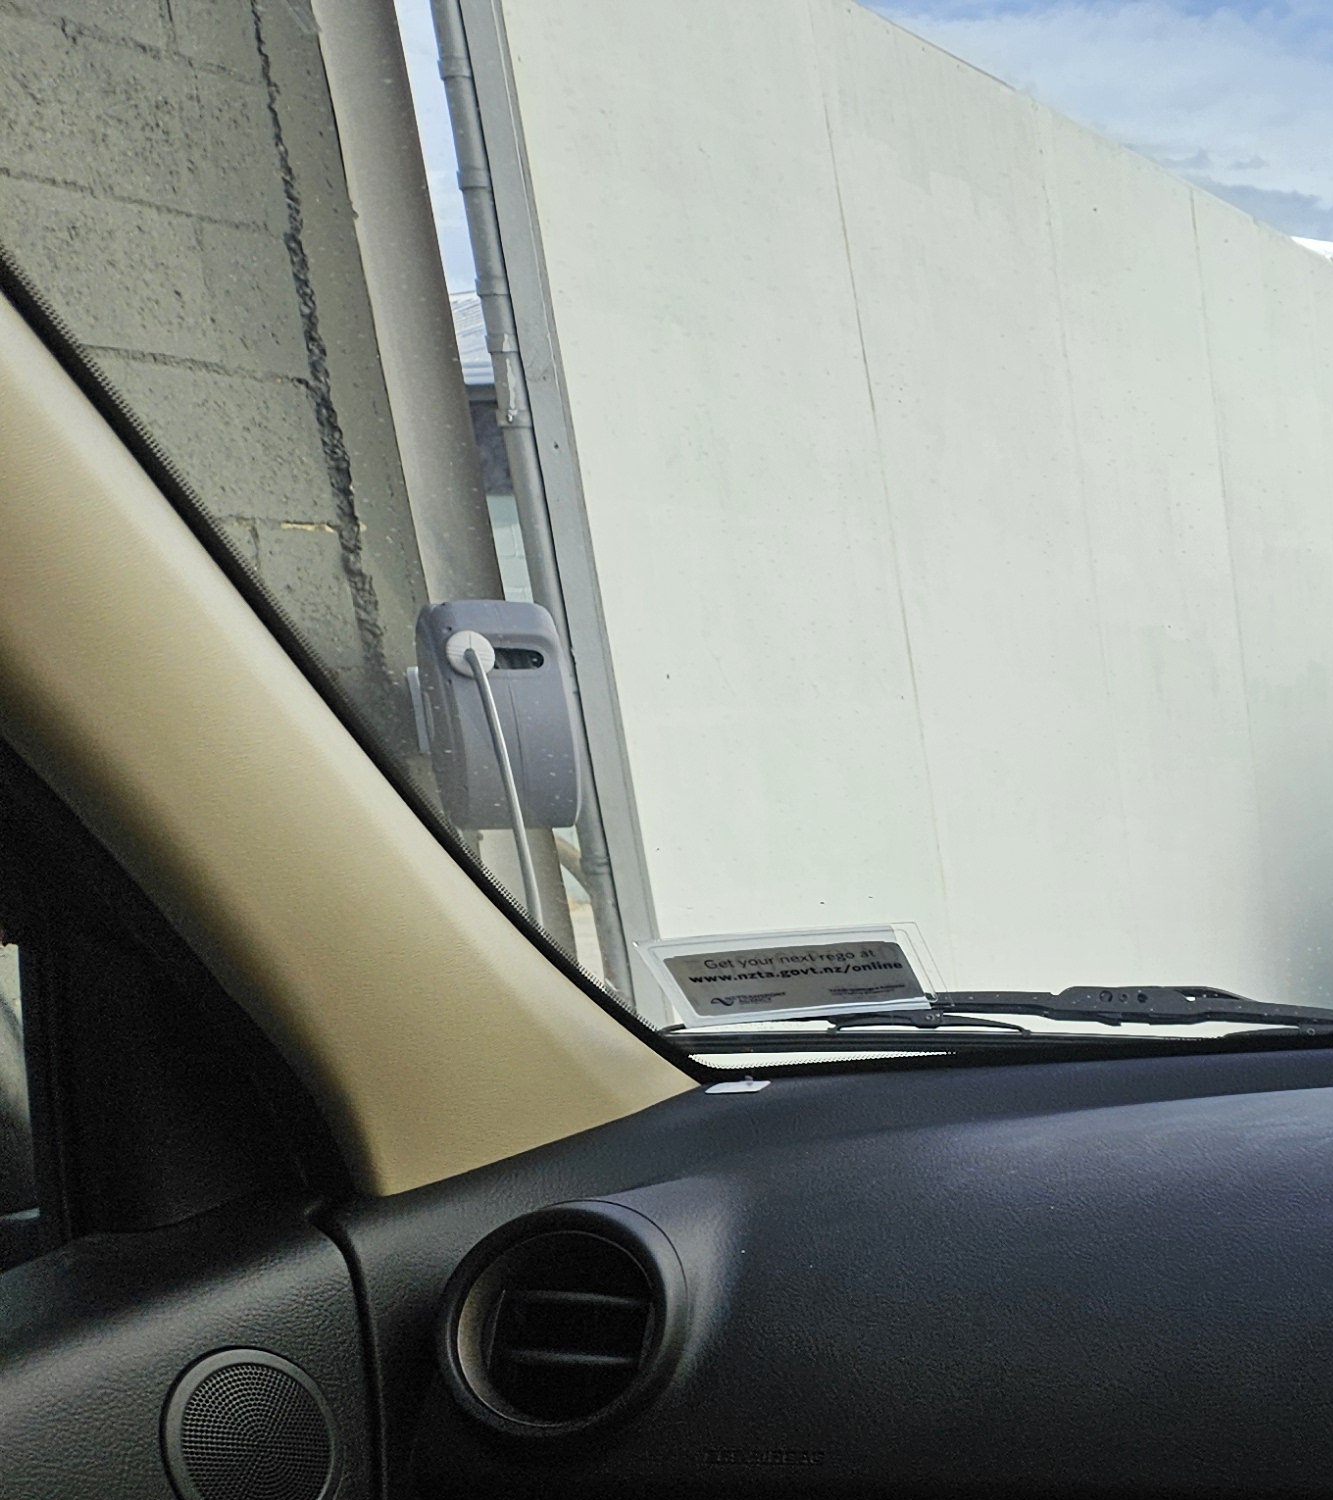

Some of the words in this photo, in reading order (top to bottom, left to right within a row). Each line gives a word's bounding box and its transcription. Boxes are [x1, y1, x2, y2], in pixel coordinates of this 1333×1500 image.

[703, 957, 736, 971] Get
[737, 955, 774, 971] your
[778, 953, 815, 966] next
[817, 950, 856, 965] rego
[859, 948, 876, 960] at
[688, 961, 905, 984] www.nzta.govt.nz/online
